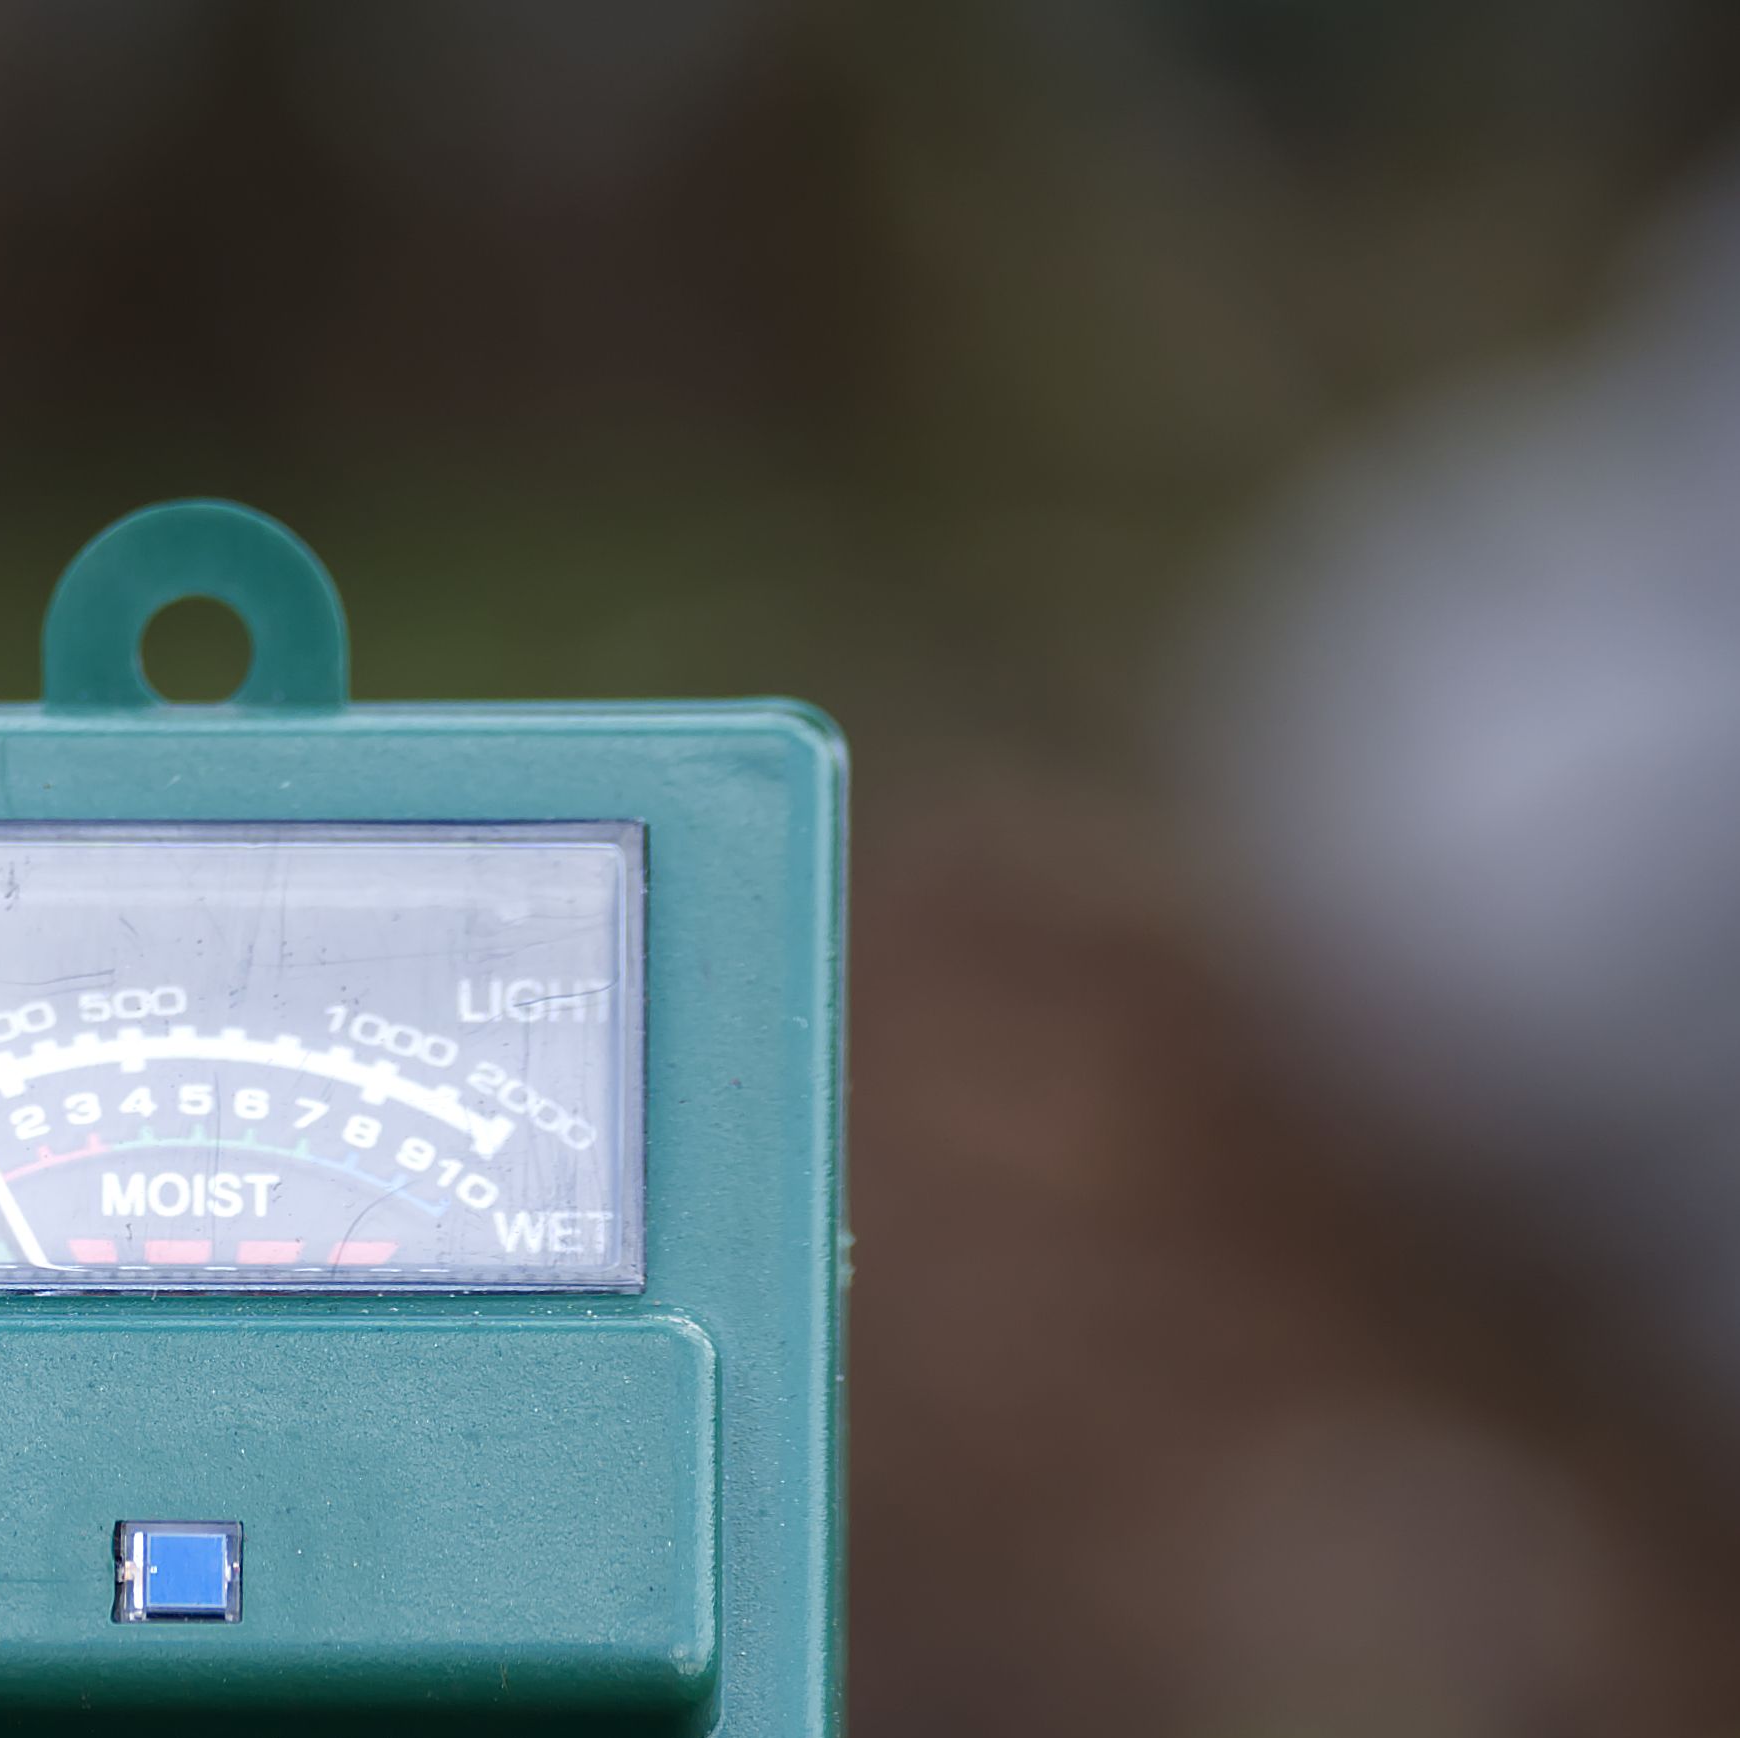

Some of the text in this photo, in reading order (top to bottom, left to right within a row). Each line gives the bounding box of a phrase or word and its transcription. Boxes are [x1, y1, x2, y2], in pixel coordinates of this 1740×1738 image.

[456, 979, 611, 1022] LIGHT
[79, 986, 187, 1022] 500
[325, 1005, 458, 1067] 1000
[466, 1061, 597, 1150] 2000
[9, 1105, 50, 1140] 2
[64, 1092, 101, 1125] 3
[119, 1087, 158, 1117] 4
[178, 1085, 214, 1115] 5
[234, 1088, 270, 1120] 6
[294, 1098, 329, 1128] 7
[342, 1114, 382, 1148] 8
[395, 1137, 436, 1171] 9
[437, 1158, 499, 1209] 10
[101, 1172, 280, 1217] MOIST
[493, 1210, 613, 1253] WET
